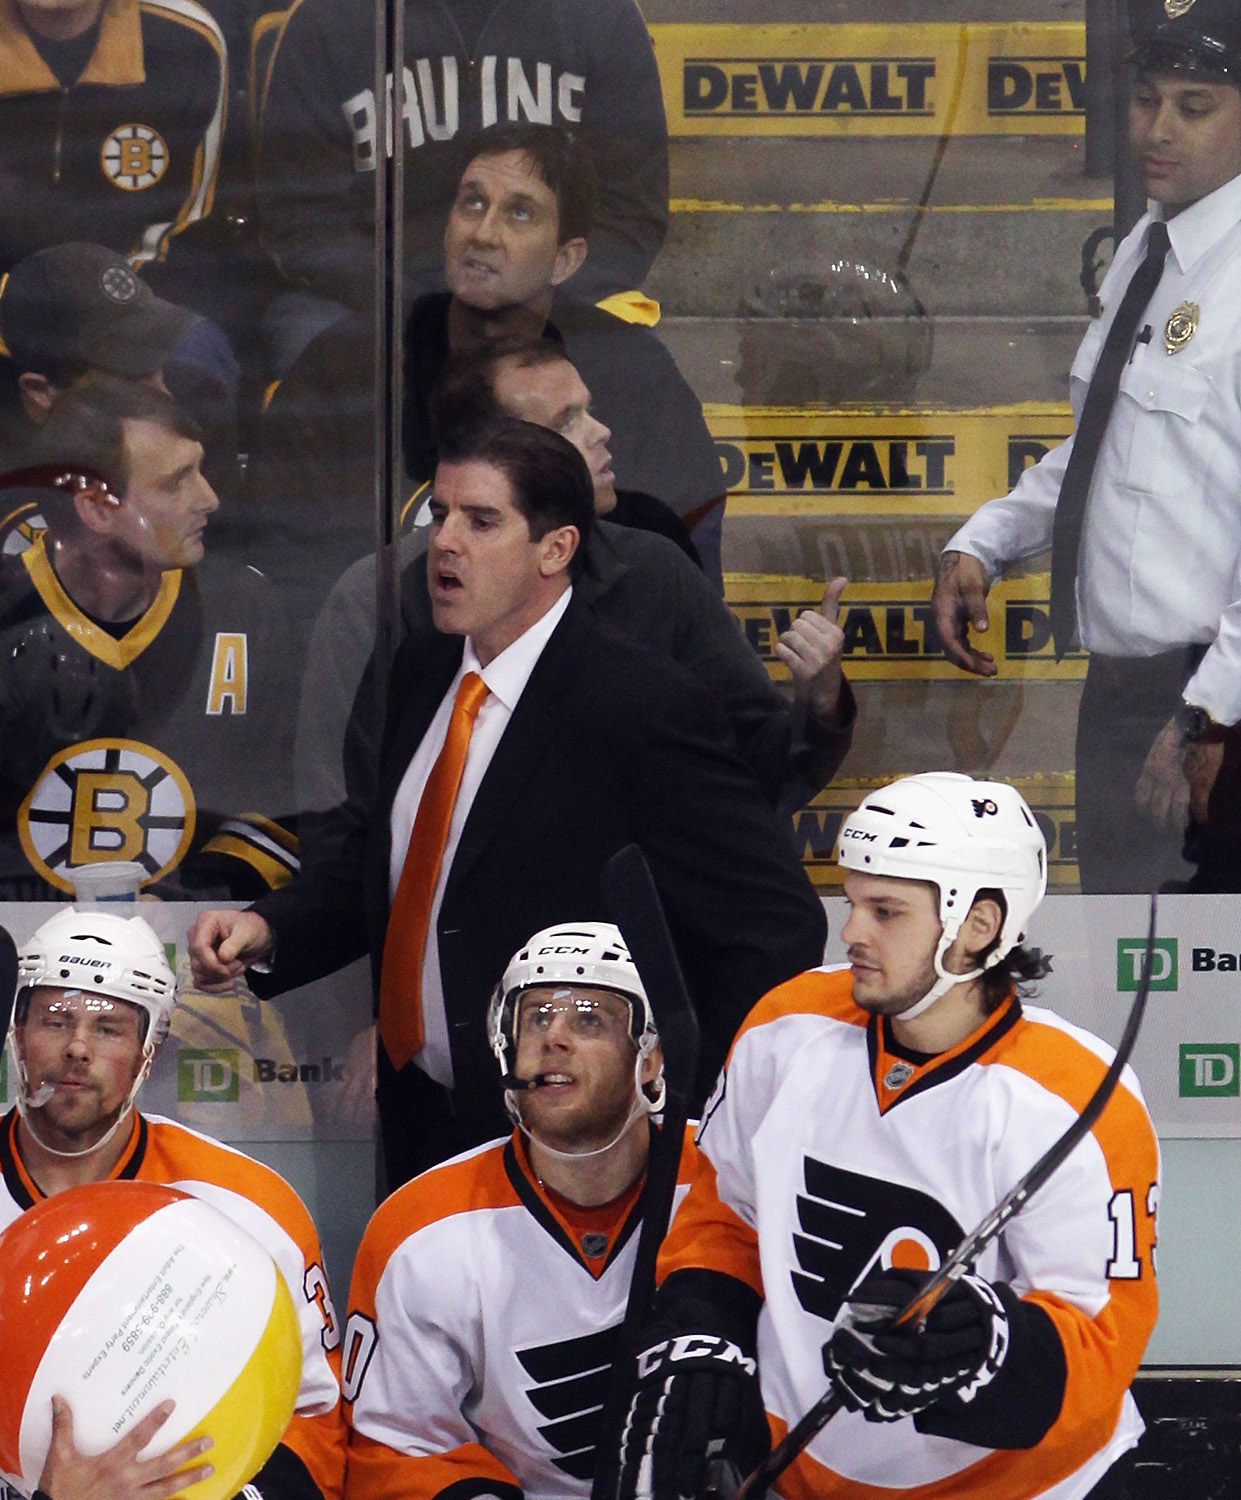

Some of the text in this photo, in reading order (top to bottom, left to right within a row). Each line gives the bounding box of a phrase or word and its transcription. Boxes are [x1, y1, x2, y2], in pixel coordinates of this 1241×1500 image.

[206, 632, 247, 715] A
[843, 827, 878, 843] CCM
[538, 946, 591, 955] CCM
[1192, 948, 1241, 972] Ba
